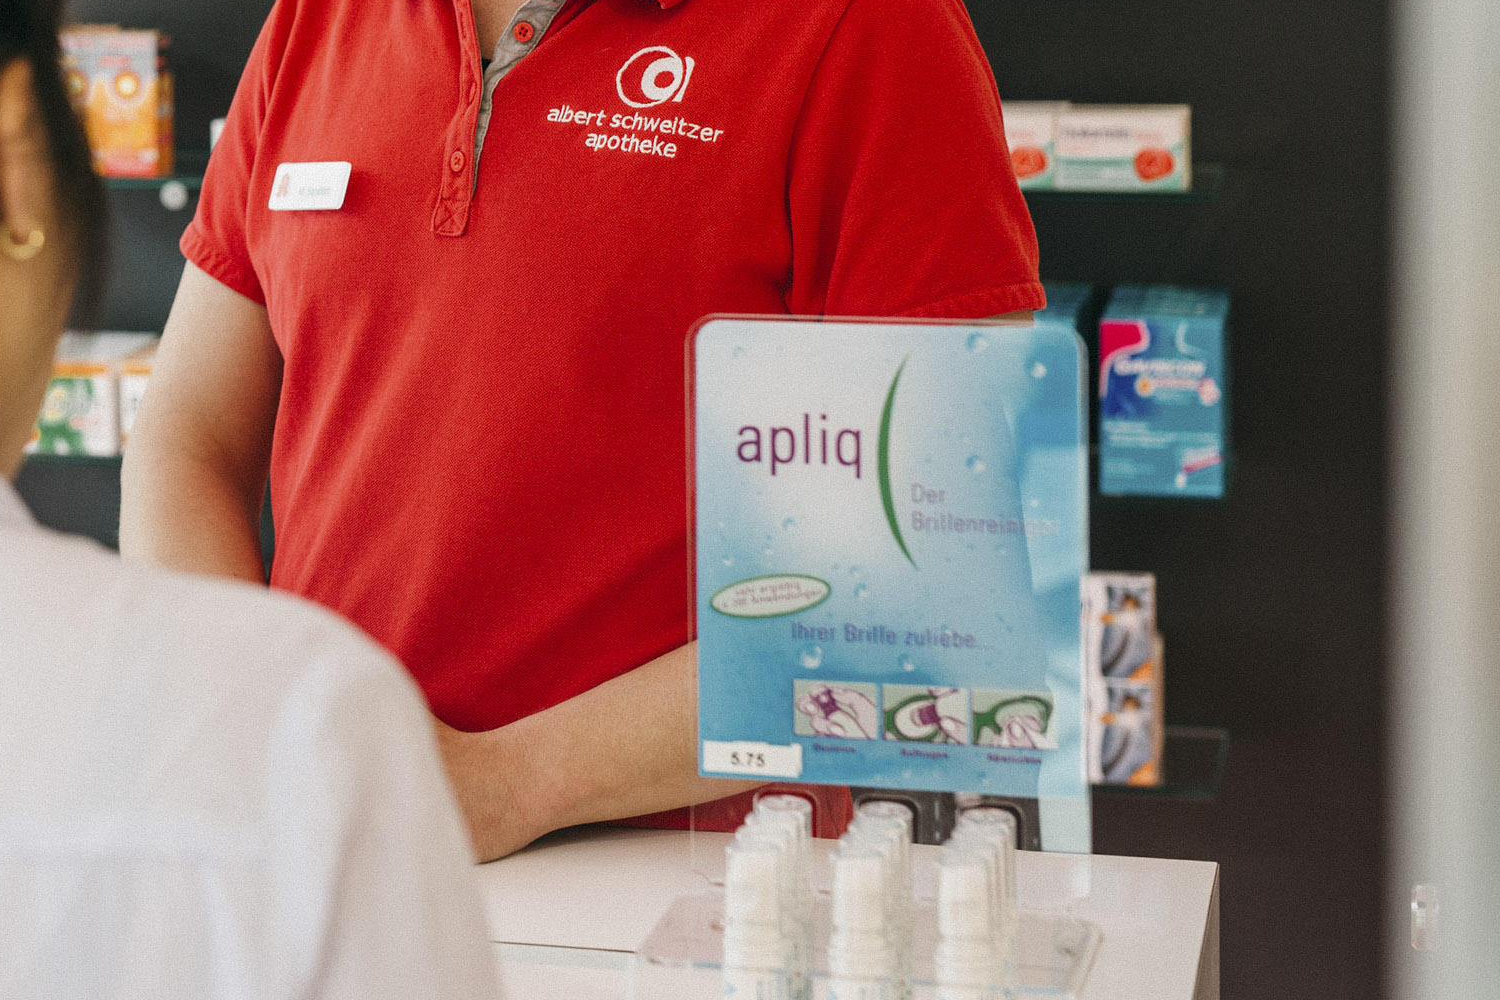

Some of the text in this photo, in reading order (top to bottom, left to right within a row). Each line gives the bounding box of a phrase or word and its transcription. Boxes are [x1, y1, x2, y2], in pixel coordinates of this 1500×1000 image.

[546, 104, 725, 144] albert schweitzer
[584, 131, 678, 159] apotheke
[736, 412, 861, 479] apliq
[910, 482, 946, 505] Der
[790, 621, 837, 643] Ihrer
[843, 621, 898, 646] Brille
[730, 750, 766, 769] 5.75
